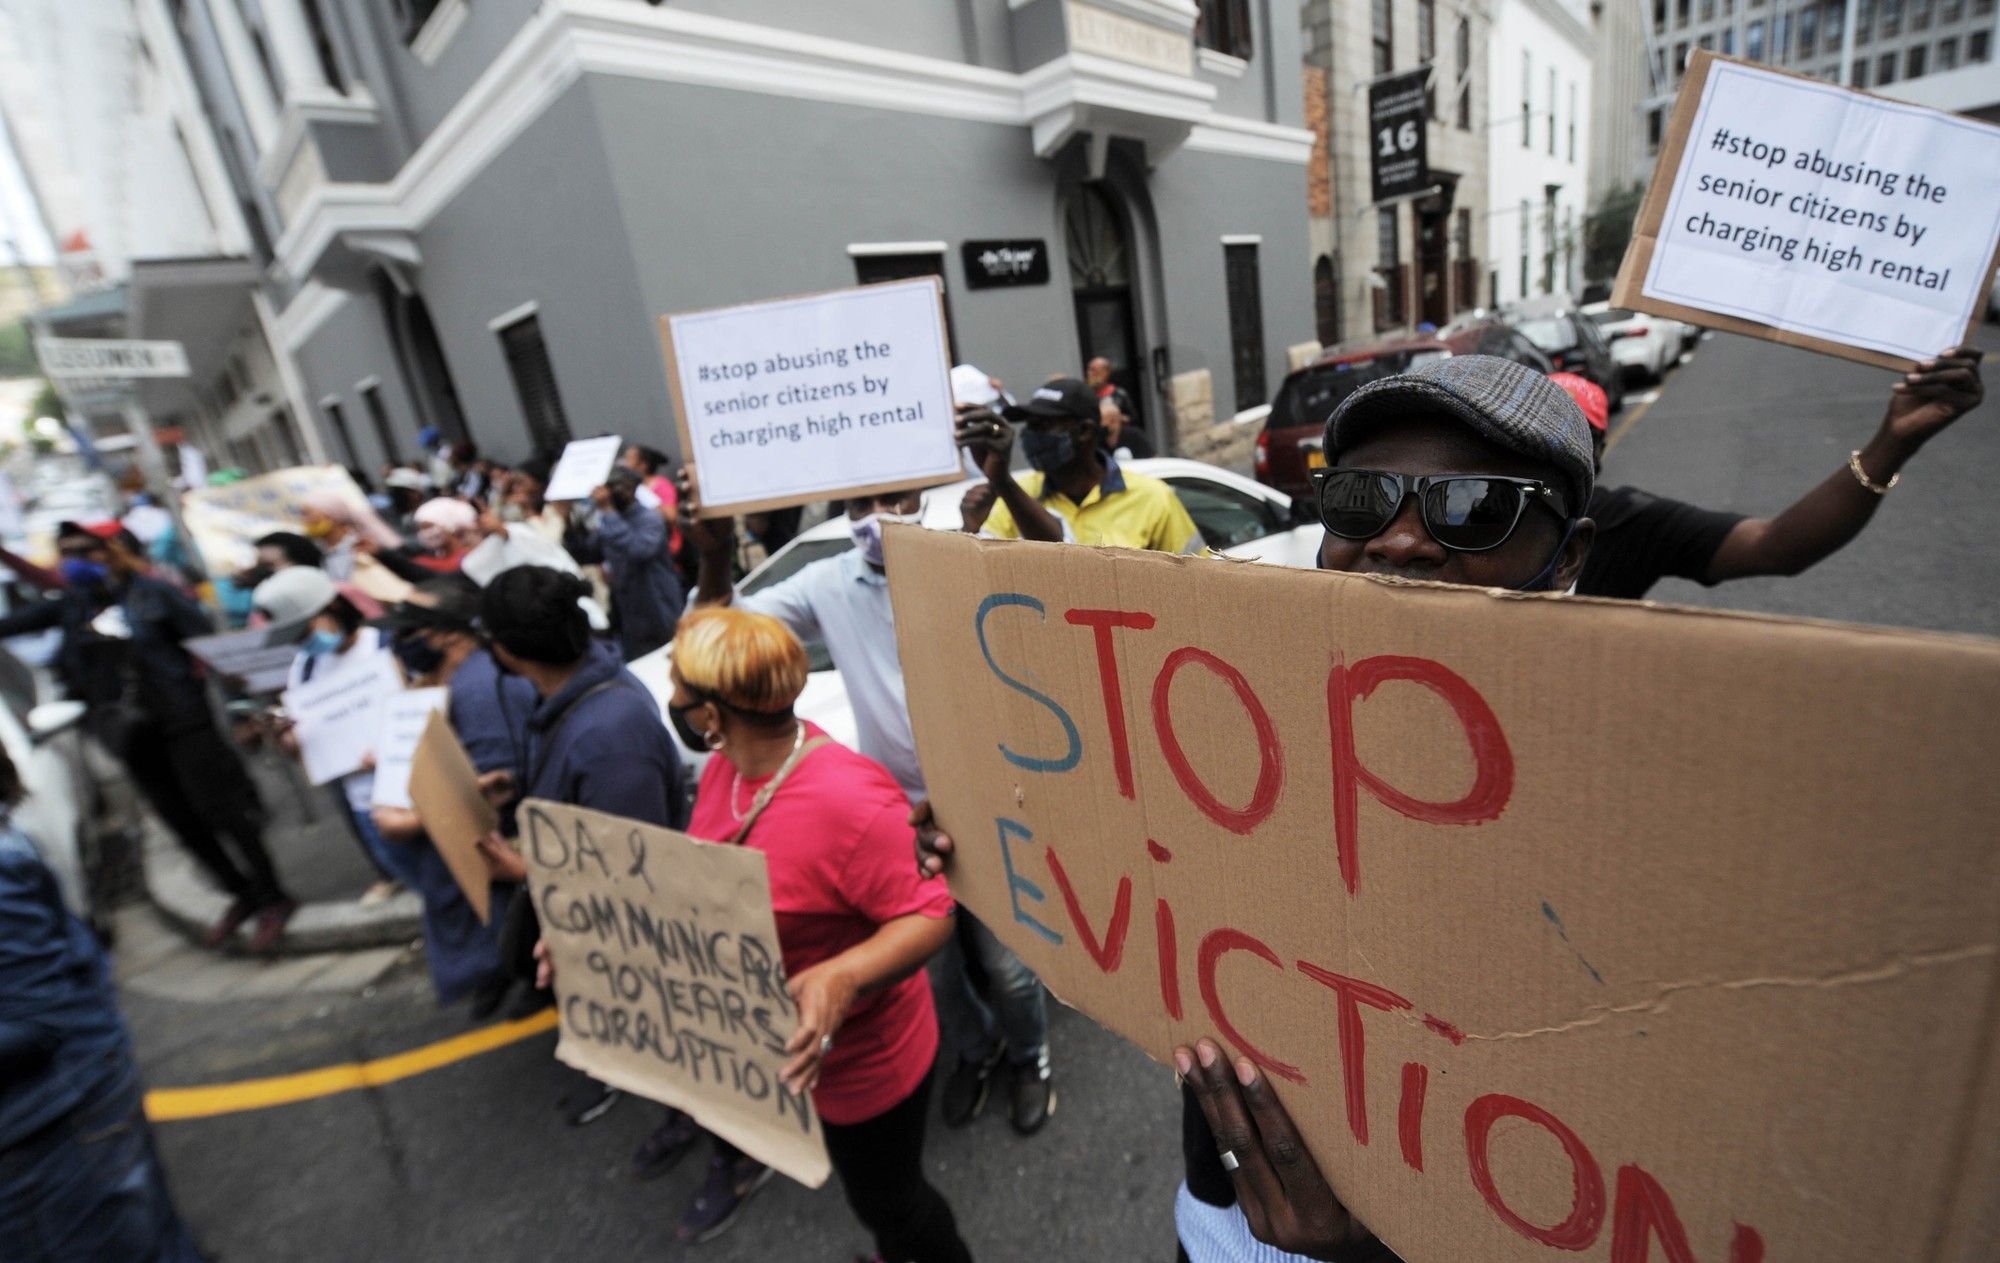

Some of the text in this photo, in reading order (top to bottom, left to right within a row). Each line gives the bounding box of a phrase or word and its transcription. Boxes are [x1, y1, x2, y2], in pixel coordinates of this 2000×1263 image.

[1378, 121, 1418, 157] 16
[1712, 128, 1947, 203] #stop abusing the
[1698, 174, 1927, 246] senior citizens by
[1686, 212, 1950, 291] charging high rental
[698, 340, 891, 382] #stop abusing the
[704, 374, 889, 416] senior citizens by
[710, 401, 924, 449] charging high rental
[976, 592, 1515, 897] STOP
[566, 995, 811, 1134] CORRUPTION
